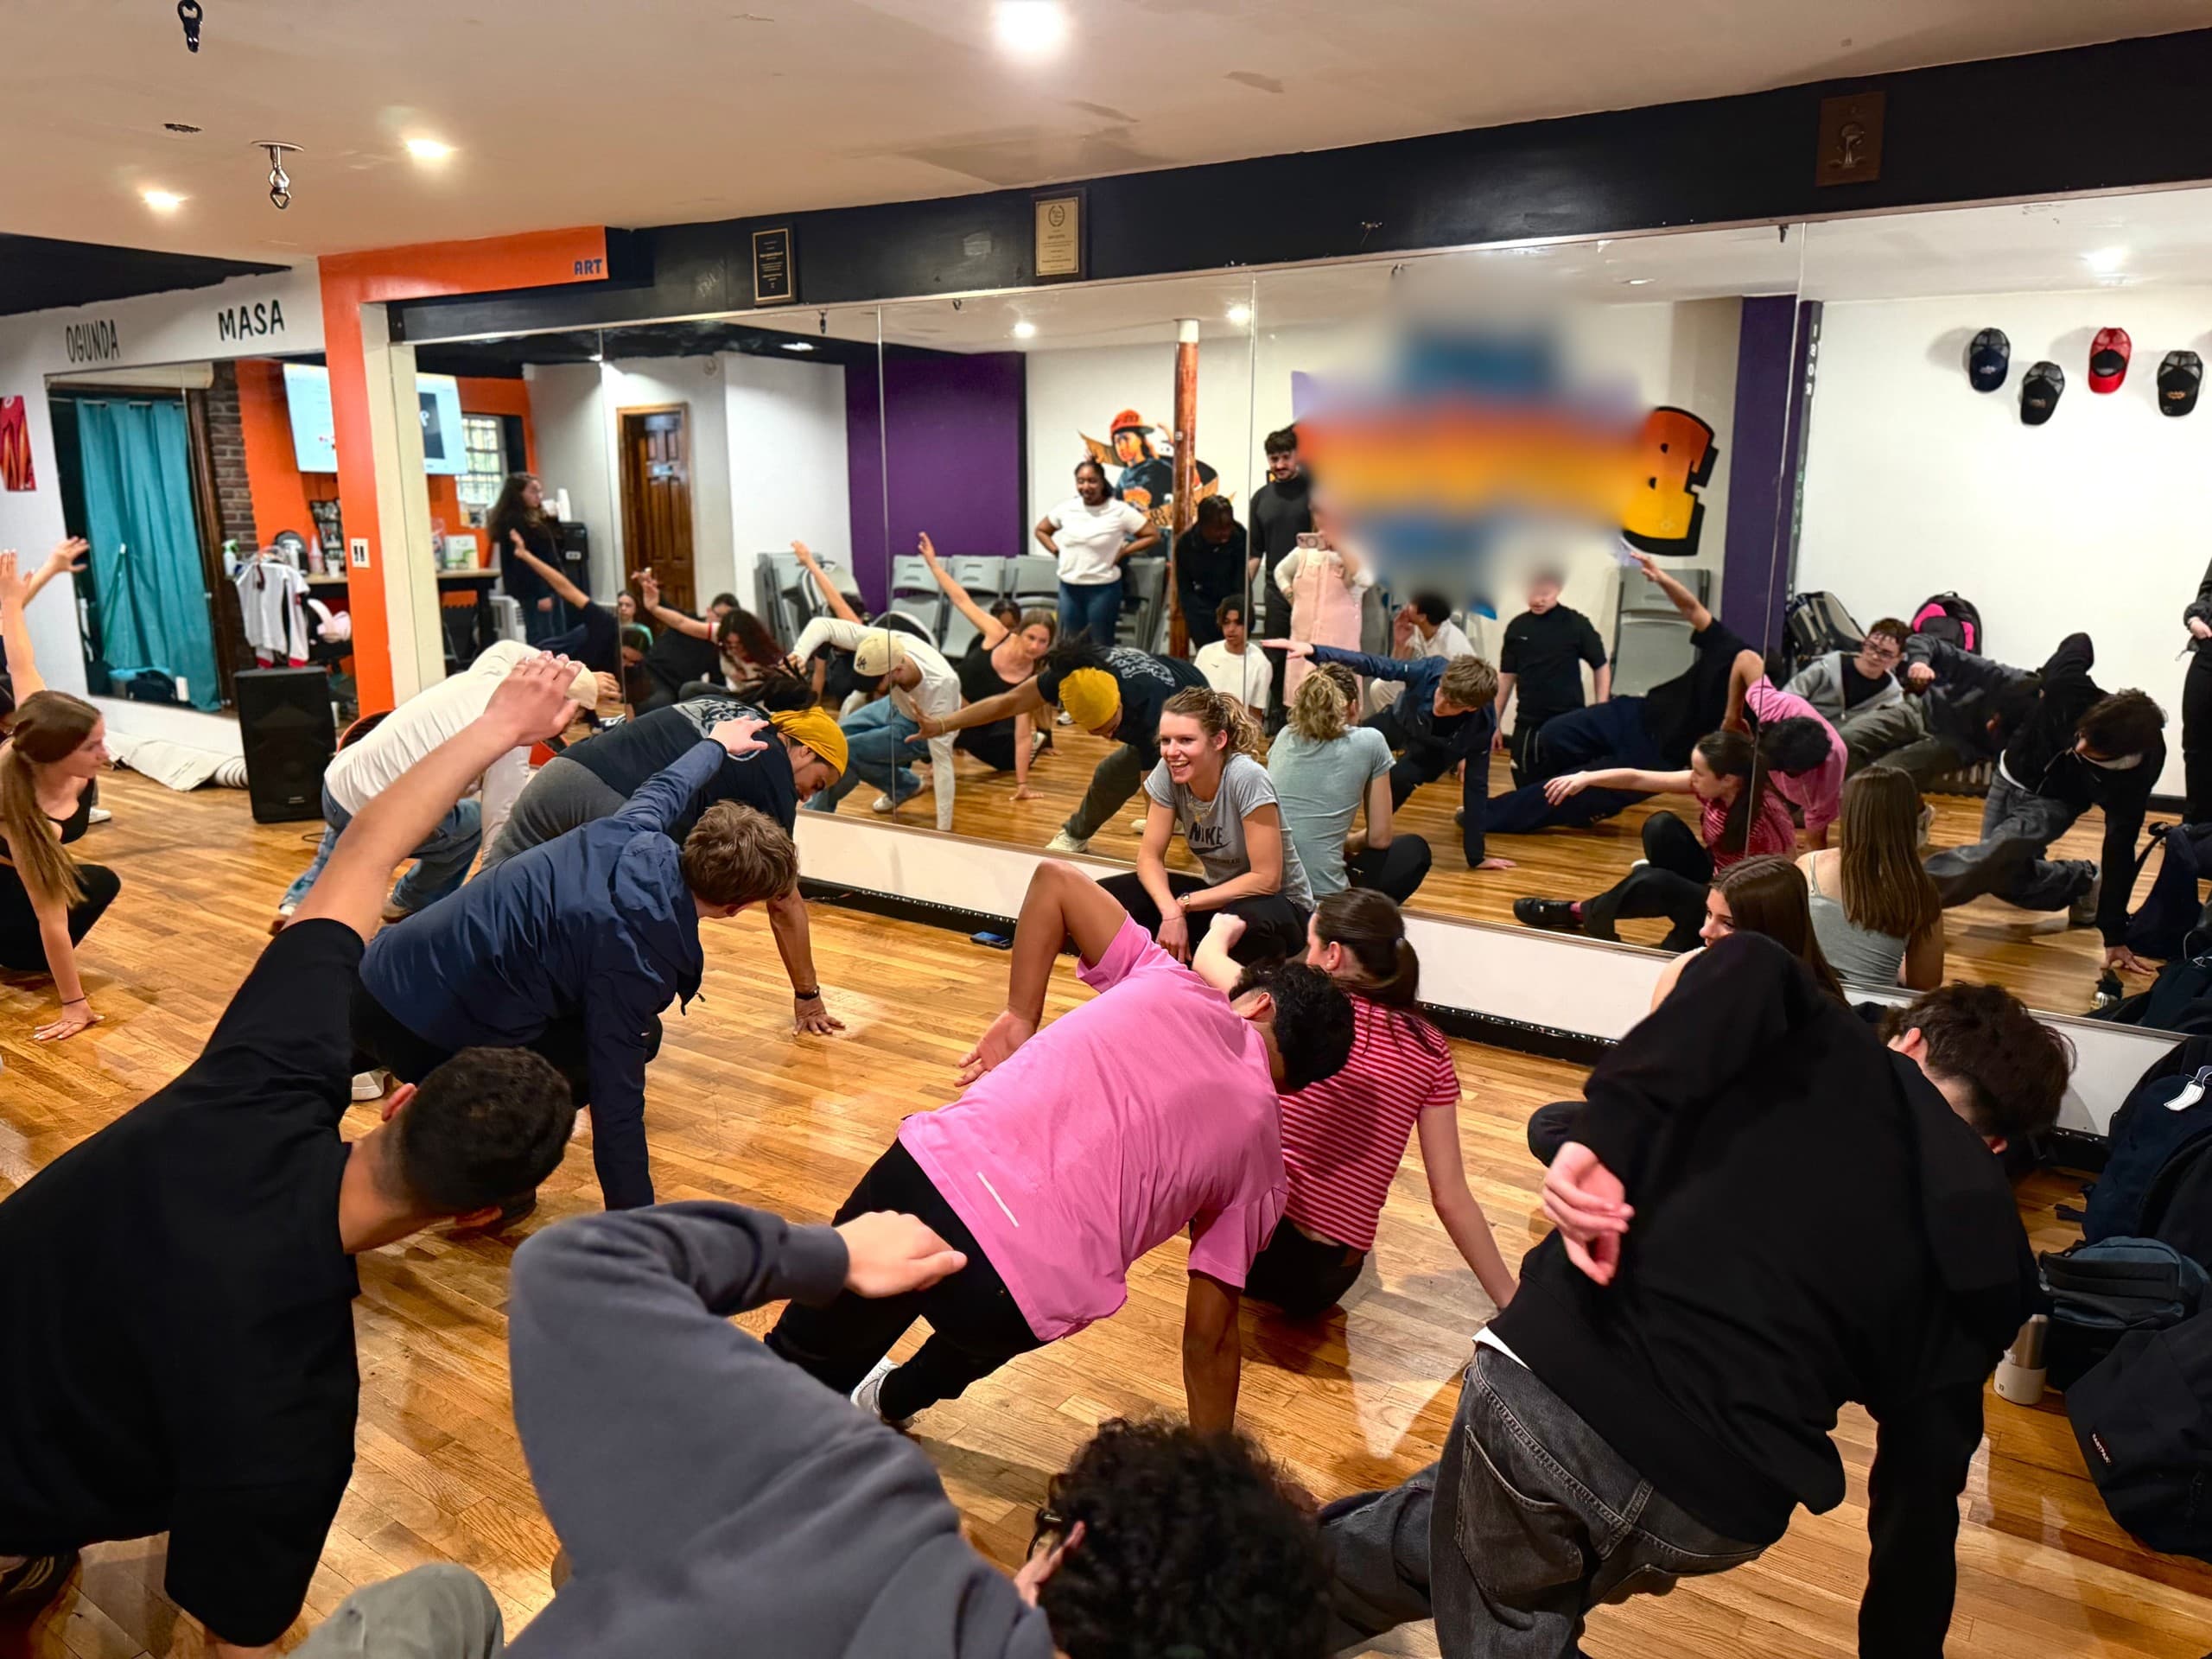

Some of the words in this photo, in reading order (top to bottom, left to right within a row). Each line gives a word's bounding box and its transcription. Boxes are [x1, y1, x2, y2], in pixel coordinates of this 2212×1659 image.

[575, 259, 602, 276] ART
[66, 319, 120, 364] OGUNDA
[218, 299, 285, 341] MASA
[1189, 822, 1224, 846] NIKE
